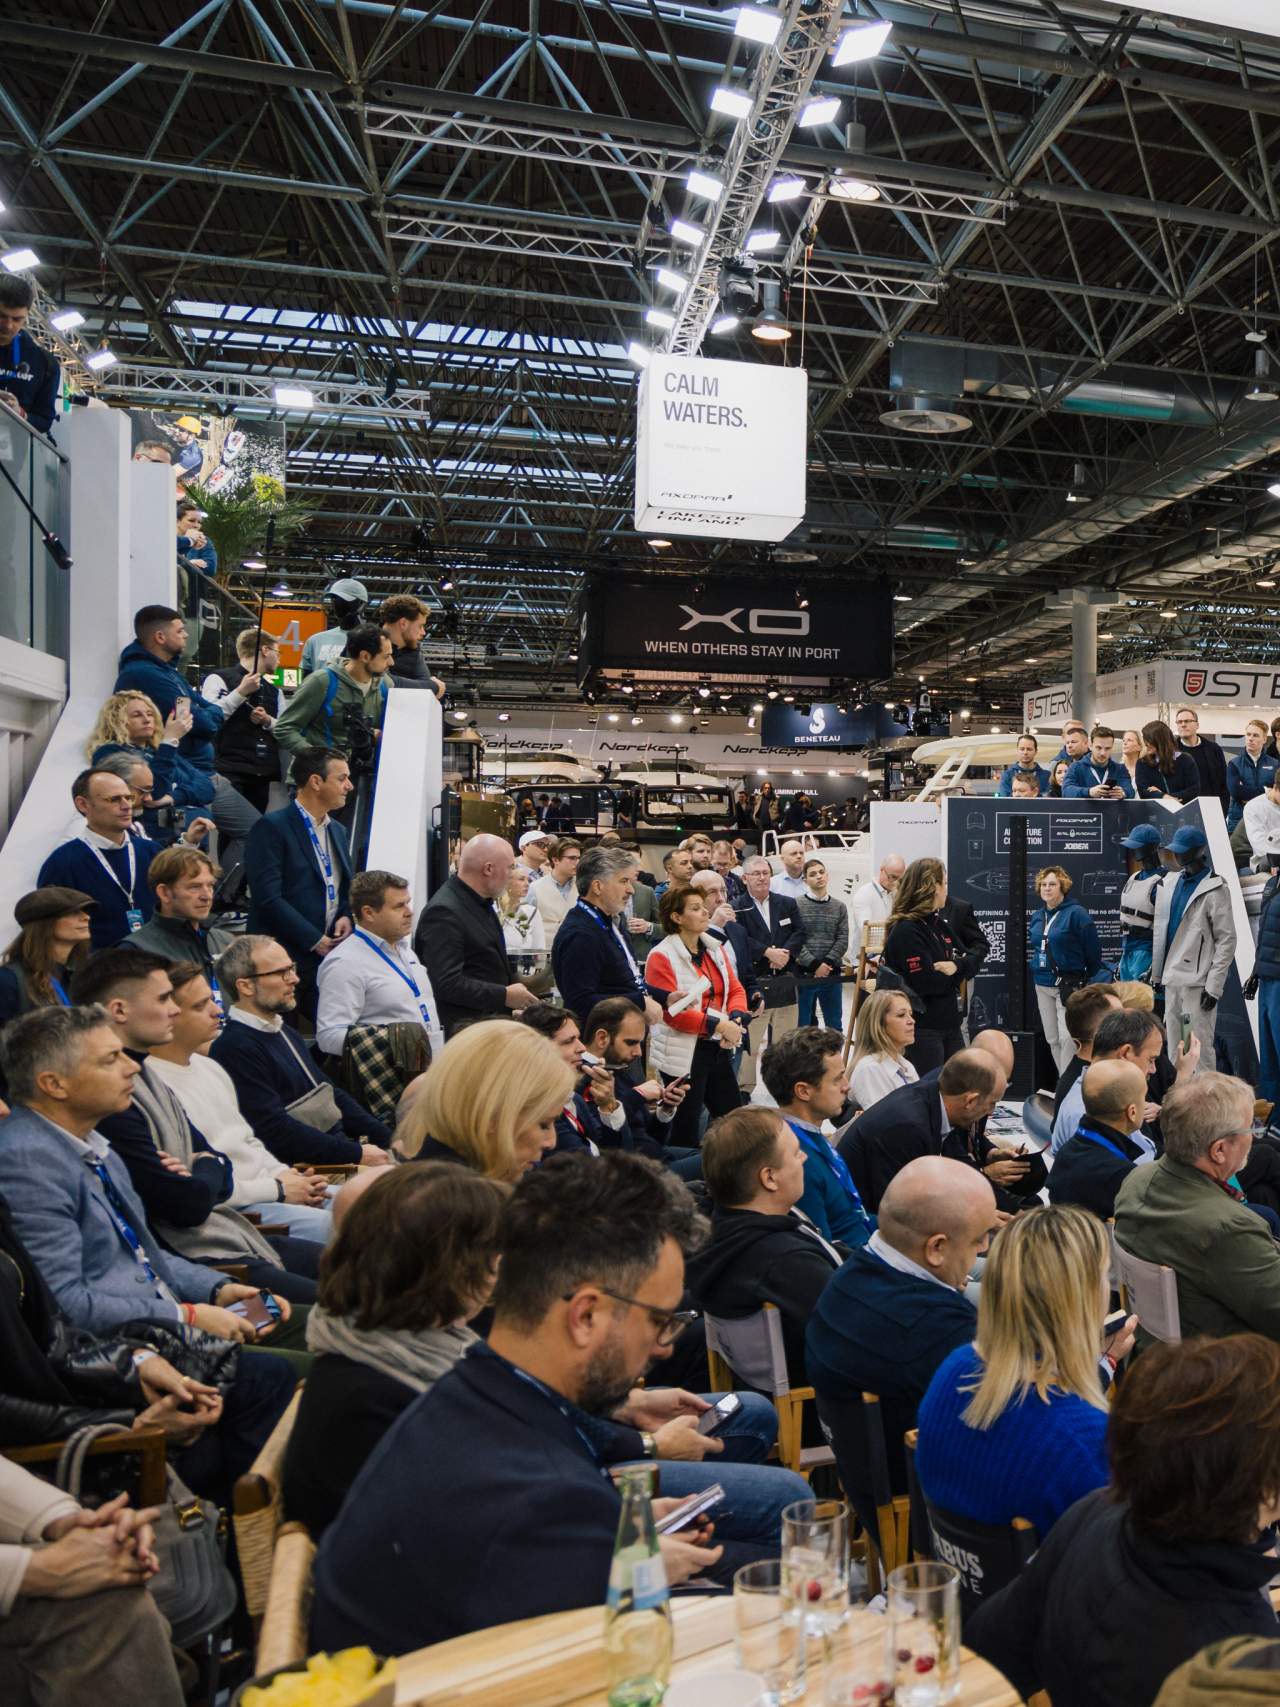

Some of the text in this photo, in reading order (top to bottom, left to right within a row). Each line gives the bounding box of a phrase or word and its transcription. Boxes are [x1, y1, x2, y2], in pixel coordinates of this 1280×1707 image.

[664, 372, 719, 397] CALM
[663, 400, 748, 428] WATERS.
[678, 605, 810, 636] XO
[279, 620, 304, 652] 4
[645, 640, 841, 660] WHEN OTHERS STAY IN PORT
[482, 736, 563, 751] ordkapp
[599, 742, 689, 754] Nordkapp
[794, 735, 841, 743] BENETEAU
[722, 744, 809, 757] Nordkapp
